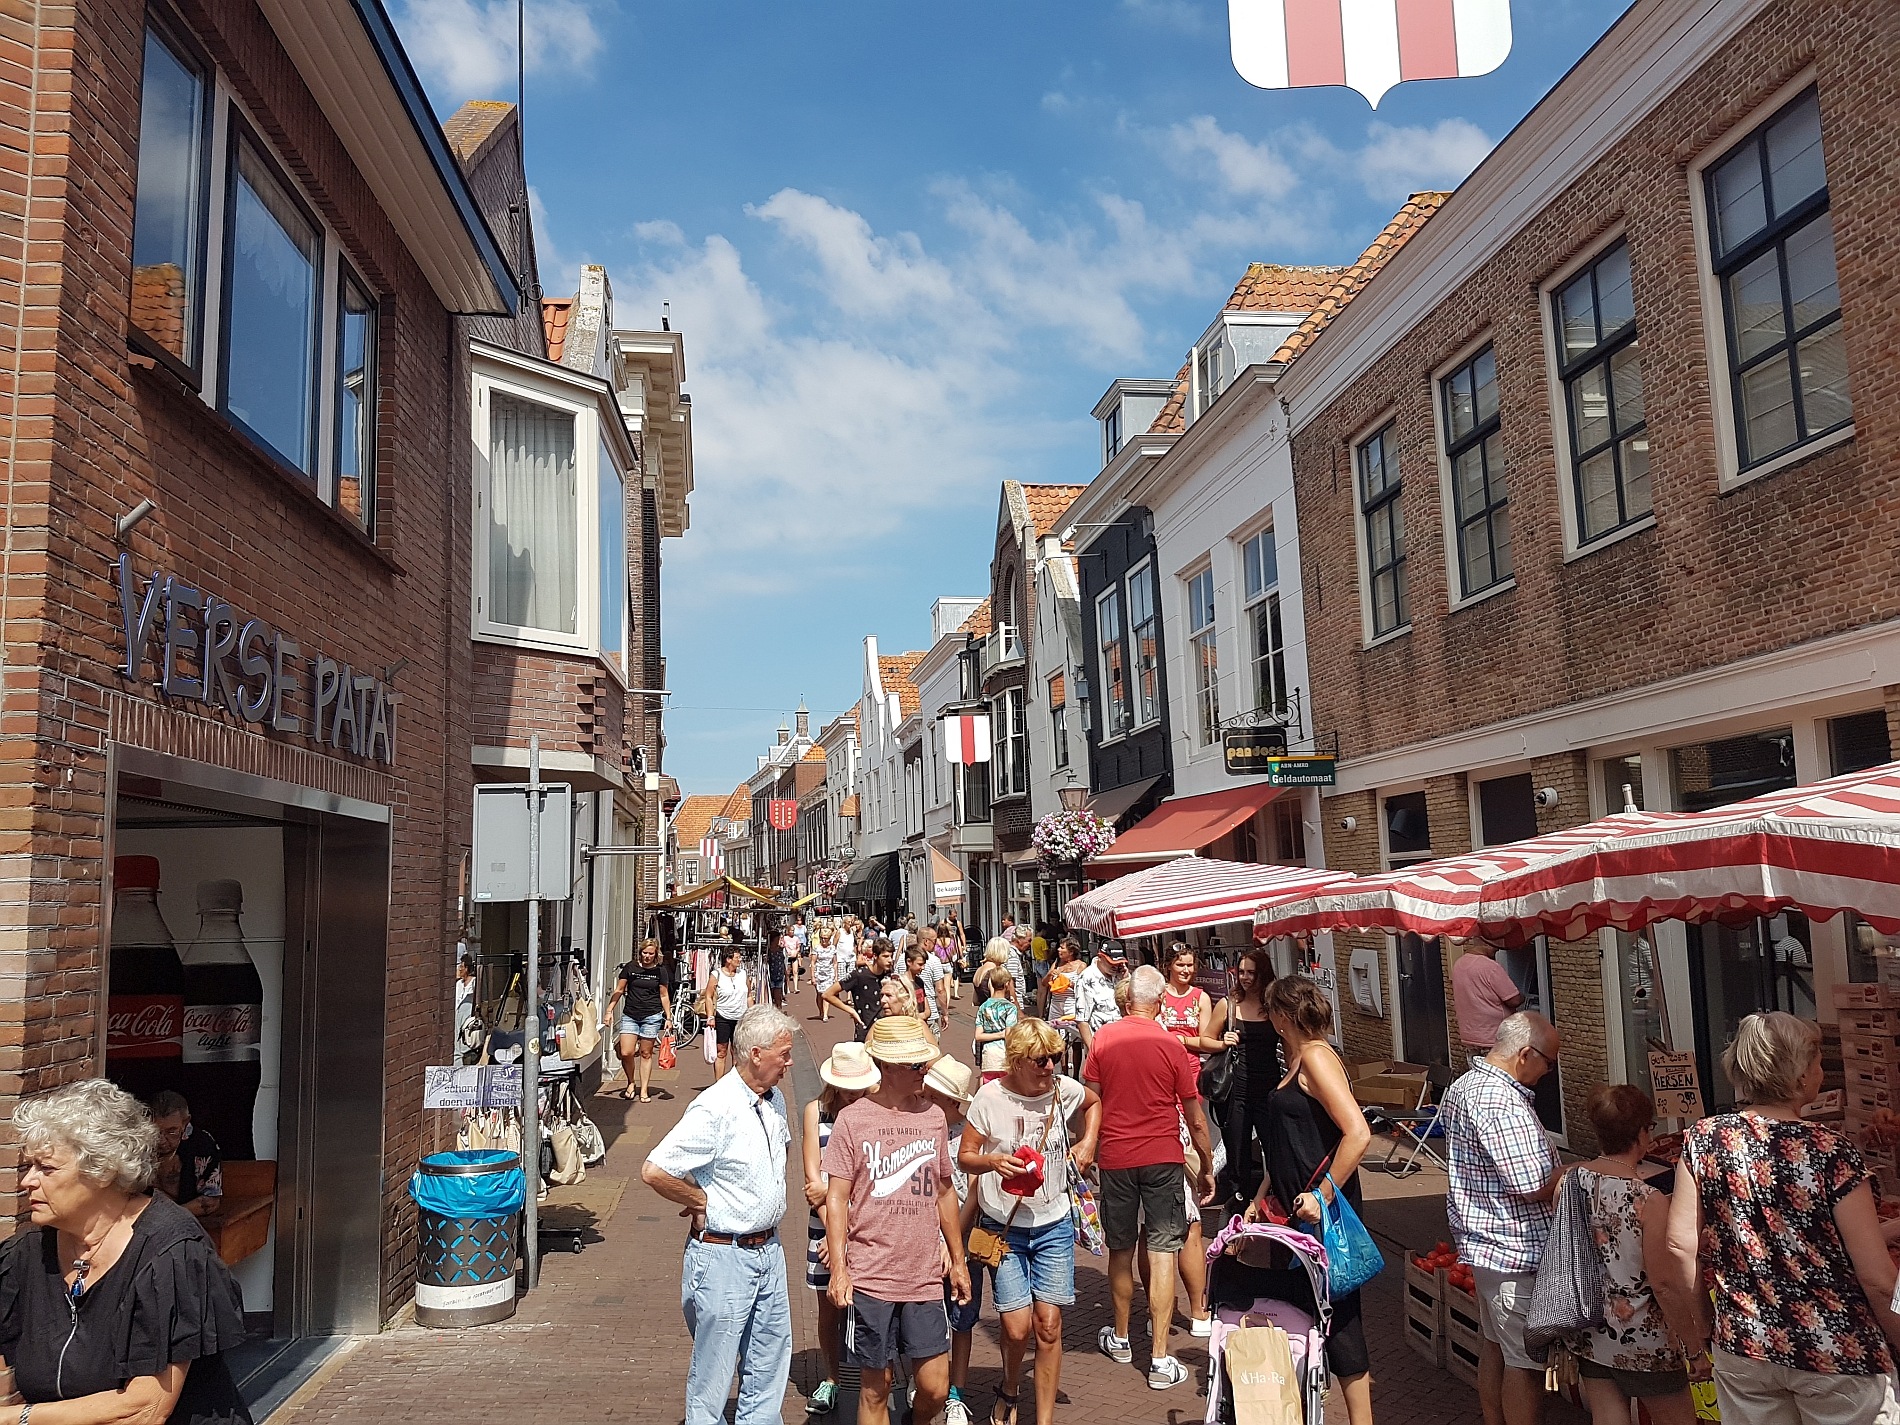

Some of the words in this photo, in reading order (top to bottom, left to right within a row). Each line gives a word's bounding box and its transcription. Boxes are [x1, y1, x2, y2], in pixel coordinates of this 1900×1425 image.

[119, 553, 301, 733] VERSE
[314, 653, 402, 766] PATAT
[1272, 773, 1332, 784] Geldautomaat
[197, 1035, 231, 1050] light
[502, 1067, 514, 1078] JP
[1652, 1070, 1693, 1088] KERSEN
[439, 1097, 462, 1107] doen
[878, 1127, 894, 1136] TRUE
[896, 1127, 921, 1136] VARSITY
[862, 1137, 937, 1181] Homewood
